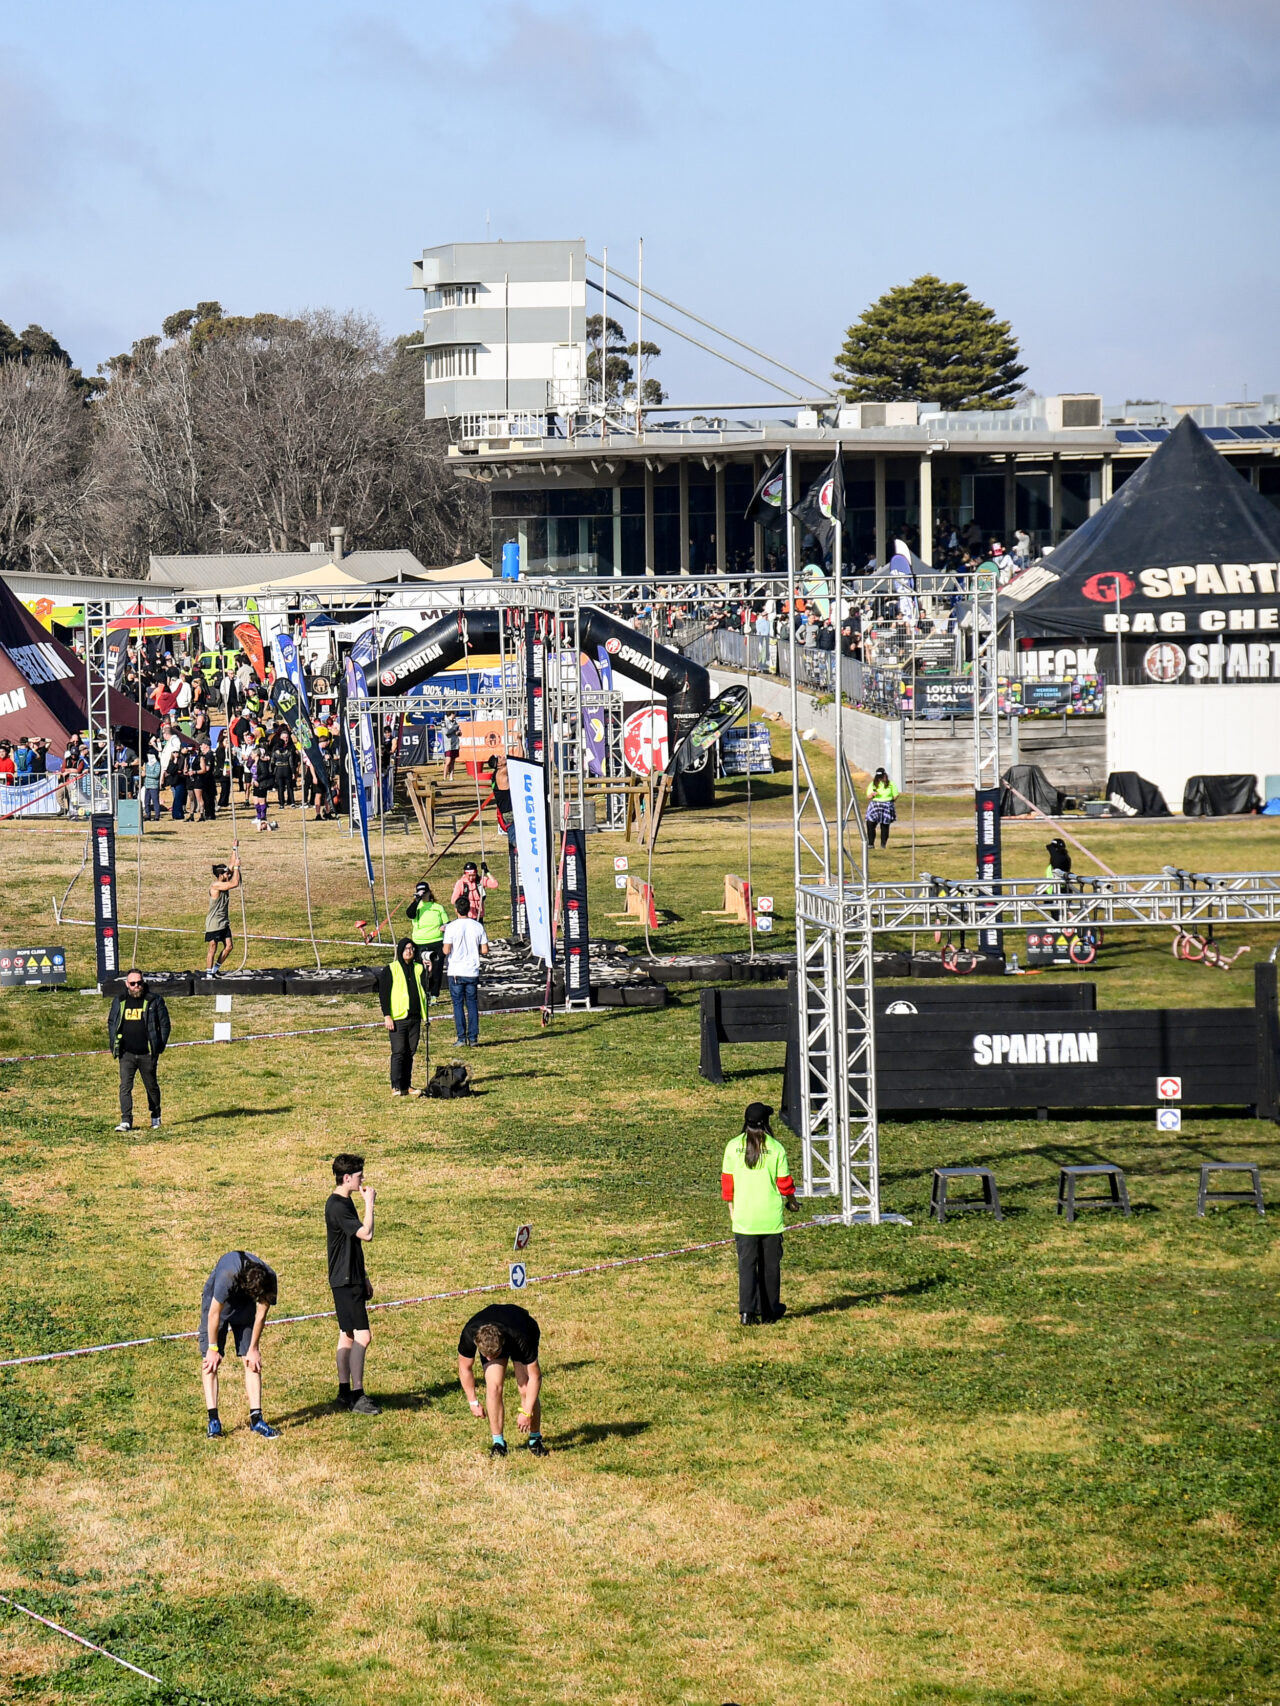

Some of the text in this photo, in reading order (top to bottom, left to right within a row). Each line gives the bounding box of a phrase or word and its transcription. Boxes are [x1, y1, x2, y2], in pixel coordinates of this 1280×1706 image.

[1104, 611, 1186, 633] BAG
[394, 642, 444, 680] SPARTAN
[618, 645, 671, 681] SPARTAN
[422, 684, 442, 696] 100%
[926, 684, 951, 694] LOVE
[926, 693, 958, 702] LOCAL
[533, 697, 543, 731] SPARTAN
[983, 811, 994, 845] SPARTAN
[98, 836, 109, 867] SPARTAN
[566, 855, 577, 891] SPARTAN
[101, 884, 112, 919] SPARTAN
[104, 936, 115, 971] SPARTAN
[569, 954, 580, 989] SPARTAN
[124, 1008, 143, 1021] CAT
[973, 1032, 1098, 1066] SPARTAN
